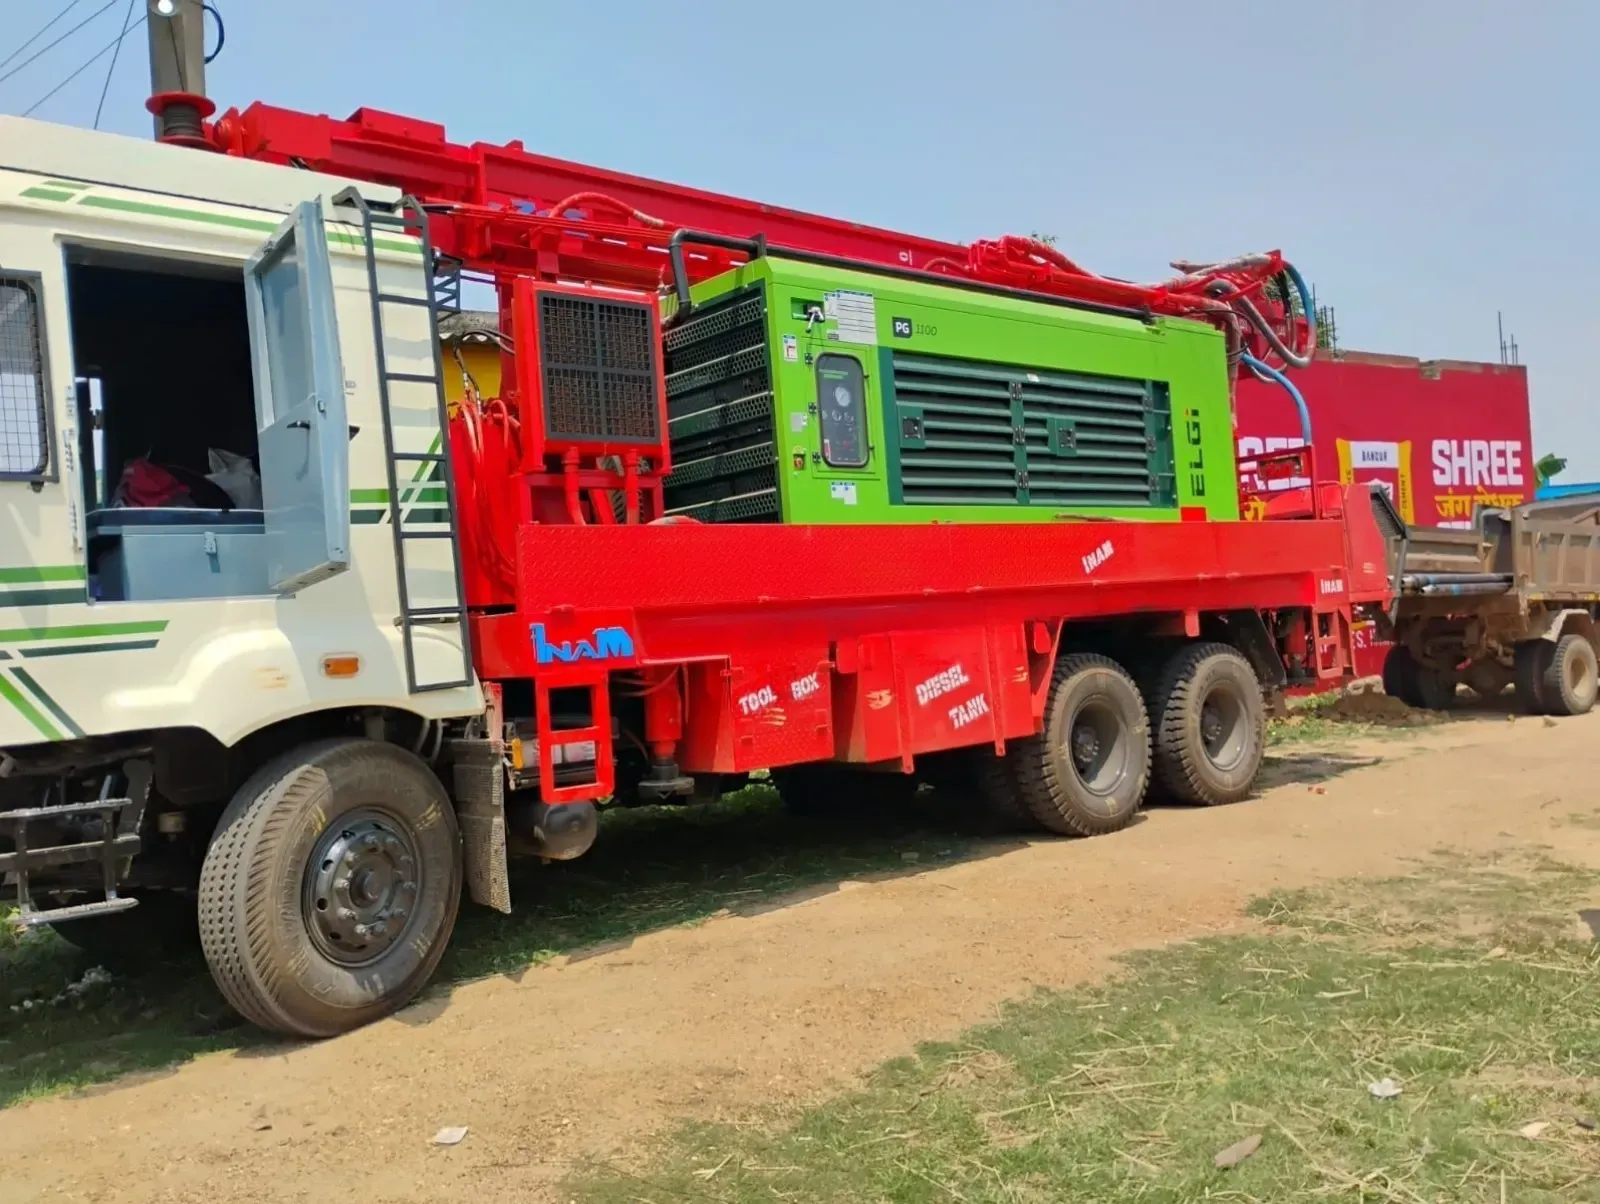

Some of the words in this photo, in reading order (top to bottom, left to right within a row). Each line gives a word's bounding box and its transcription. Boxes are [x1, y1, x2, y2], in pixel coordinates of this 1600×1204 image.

[895, 321, 910, 334] PG
[916, 323, 938, 336] 1100
[1432, 439, 1524, 486] SHREE
[1081, 540, 1114, 574] INAM
[738, 685, 778, 715] TOOL
[791, 672, 819, 701] BOX
[915, 664, 970, 707] DIESEL
[948, 693, 989, 729] TANK
